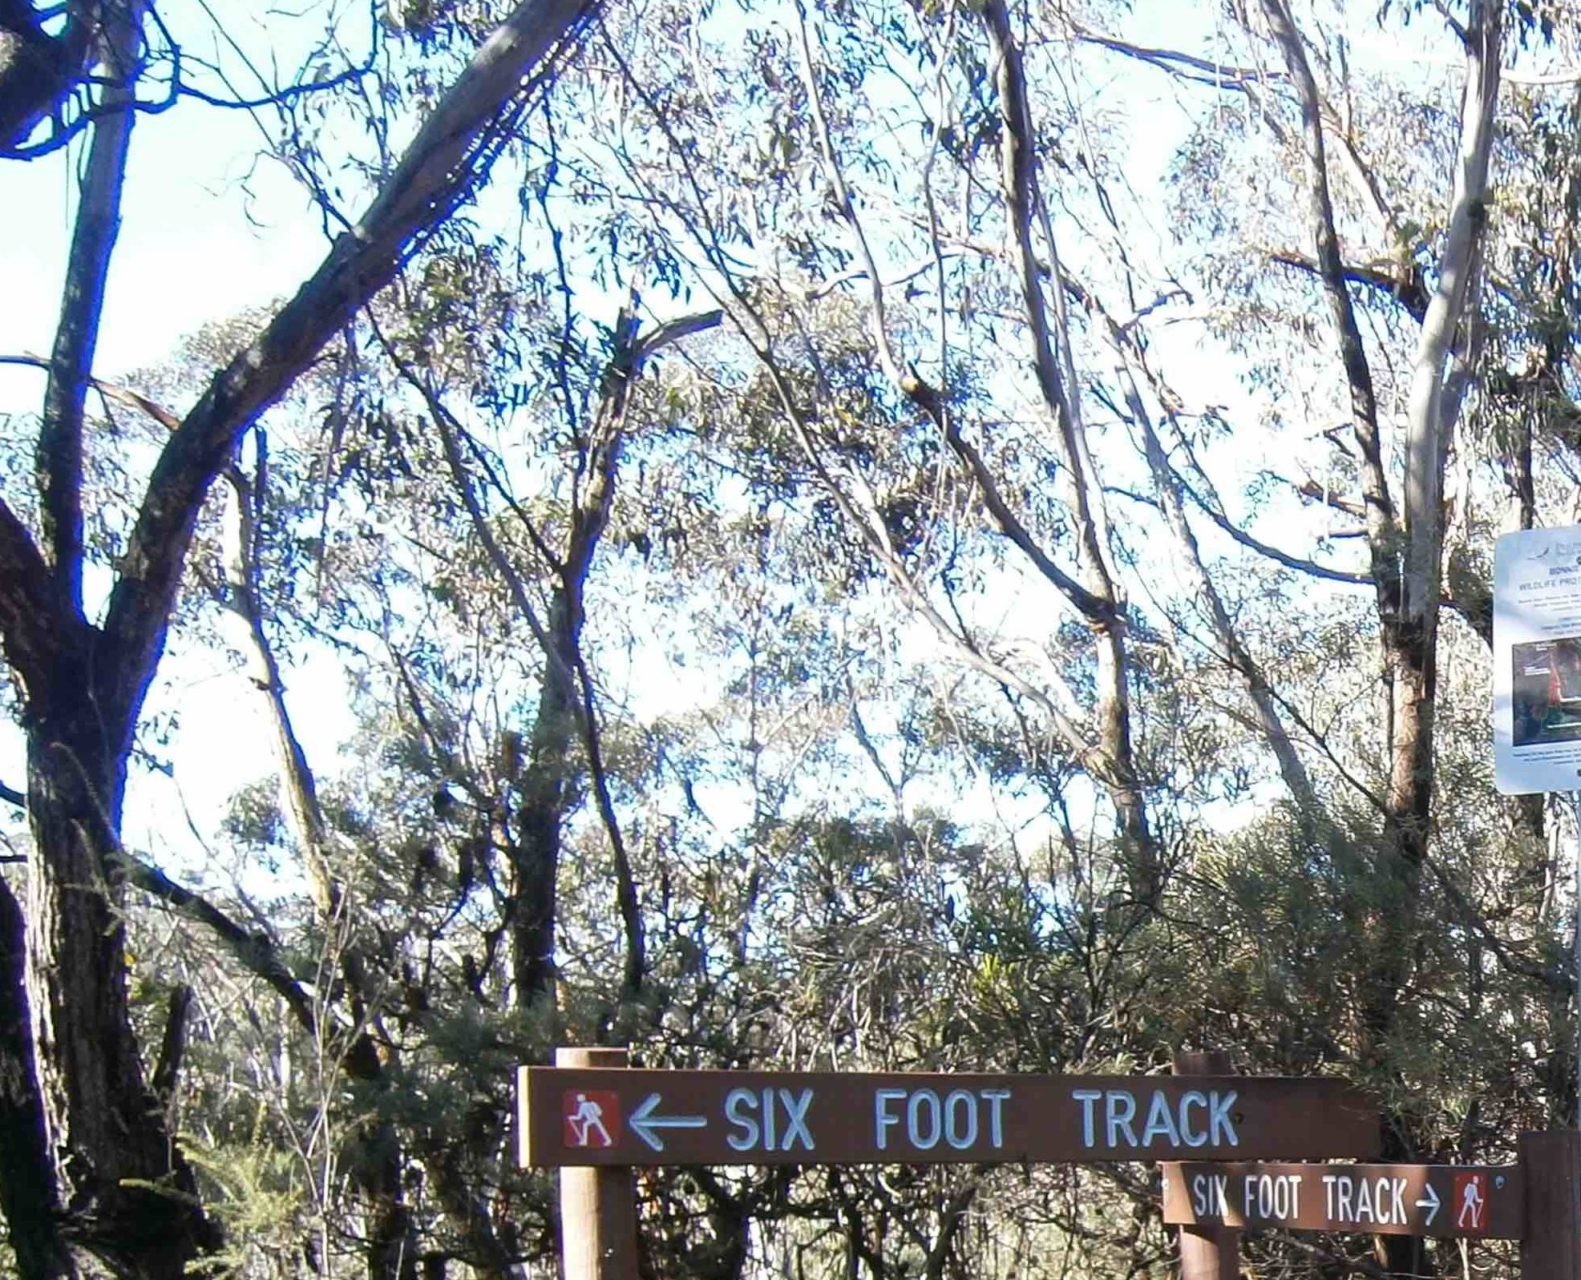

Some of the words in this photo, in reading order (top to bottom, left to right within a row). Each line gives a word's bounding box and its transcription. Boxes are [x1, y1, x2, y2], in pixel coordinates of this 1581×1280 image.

[723, 1087, 816, 1152] SIX
[873, 1087, 1011, 1151] FOOT
[1072, 1089, 1239, 1149] TRACK
[1193, 1174, 1228, 1218] SIX
[1244, 1173, 1302, 1221] FOOT
[1321, 1174, 1407, 1225] TRACK
